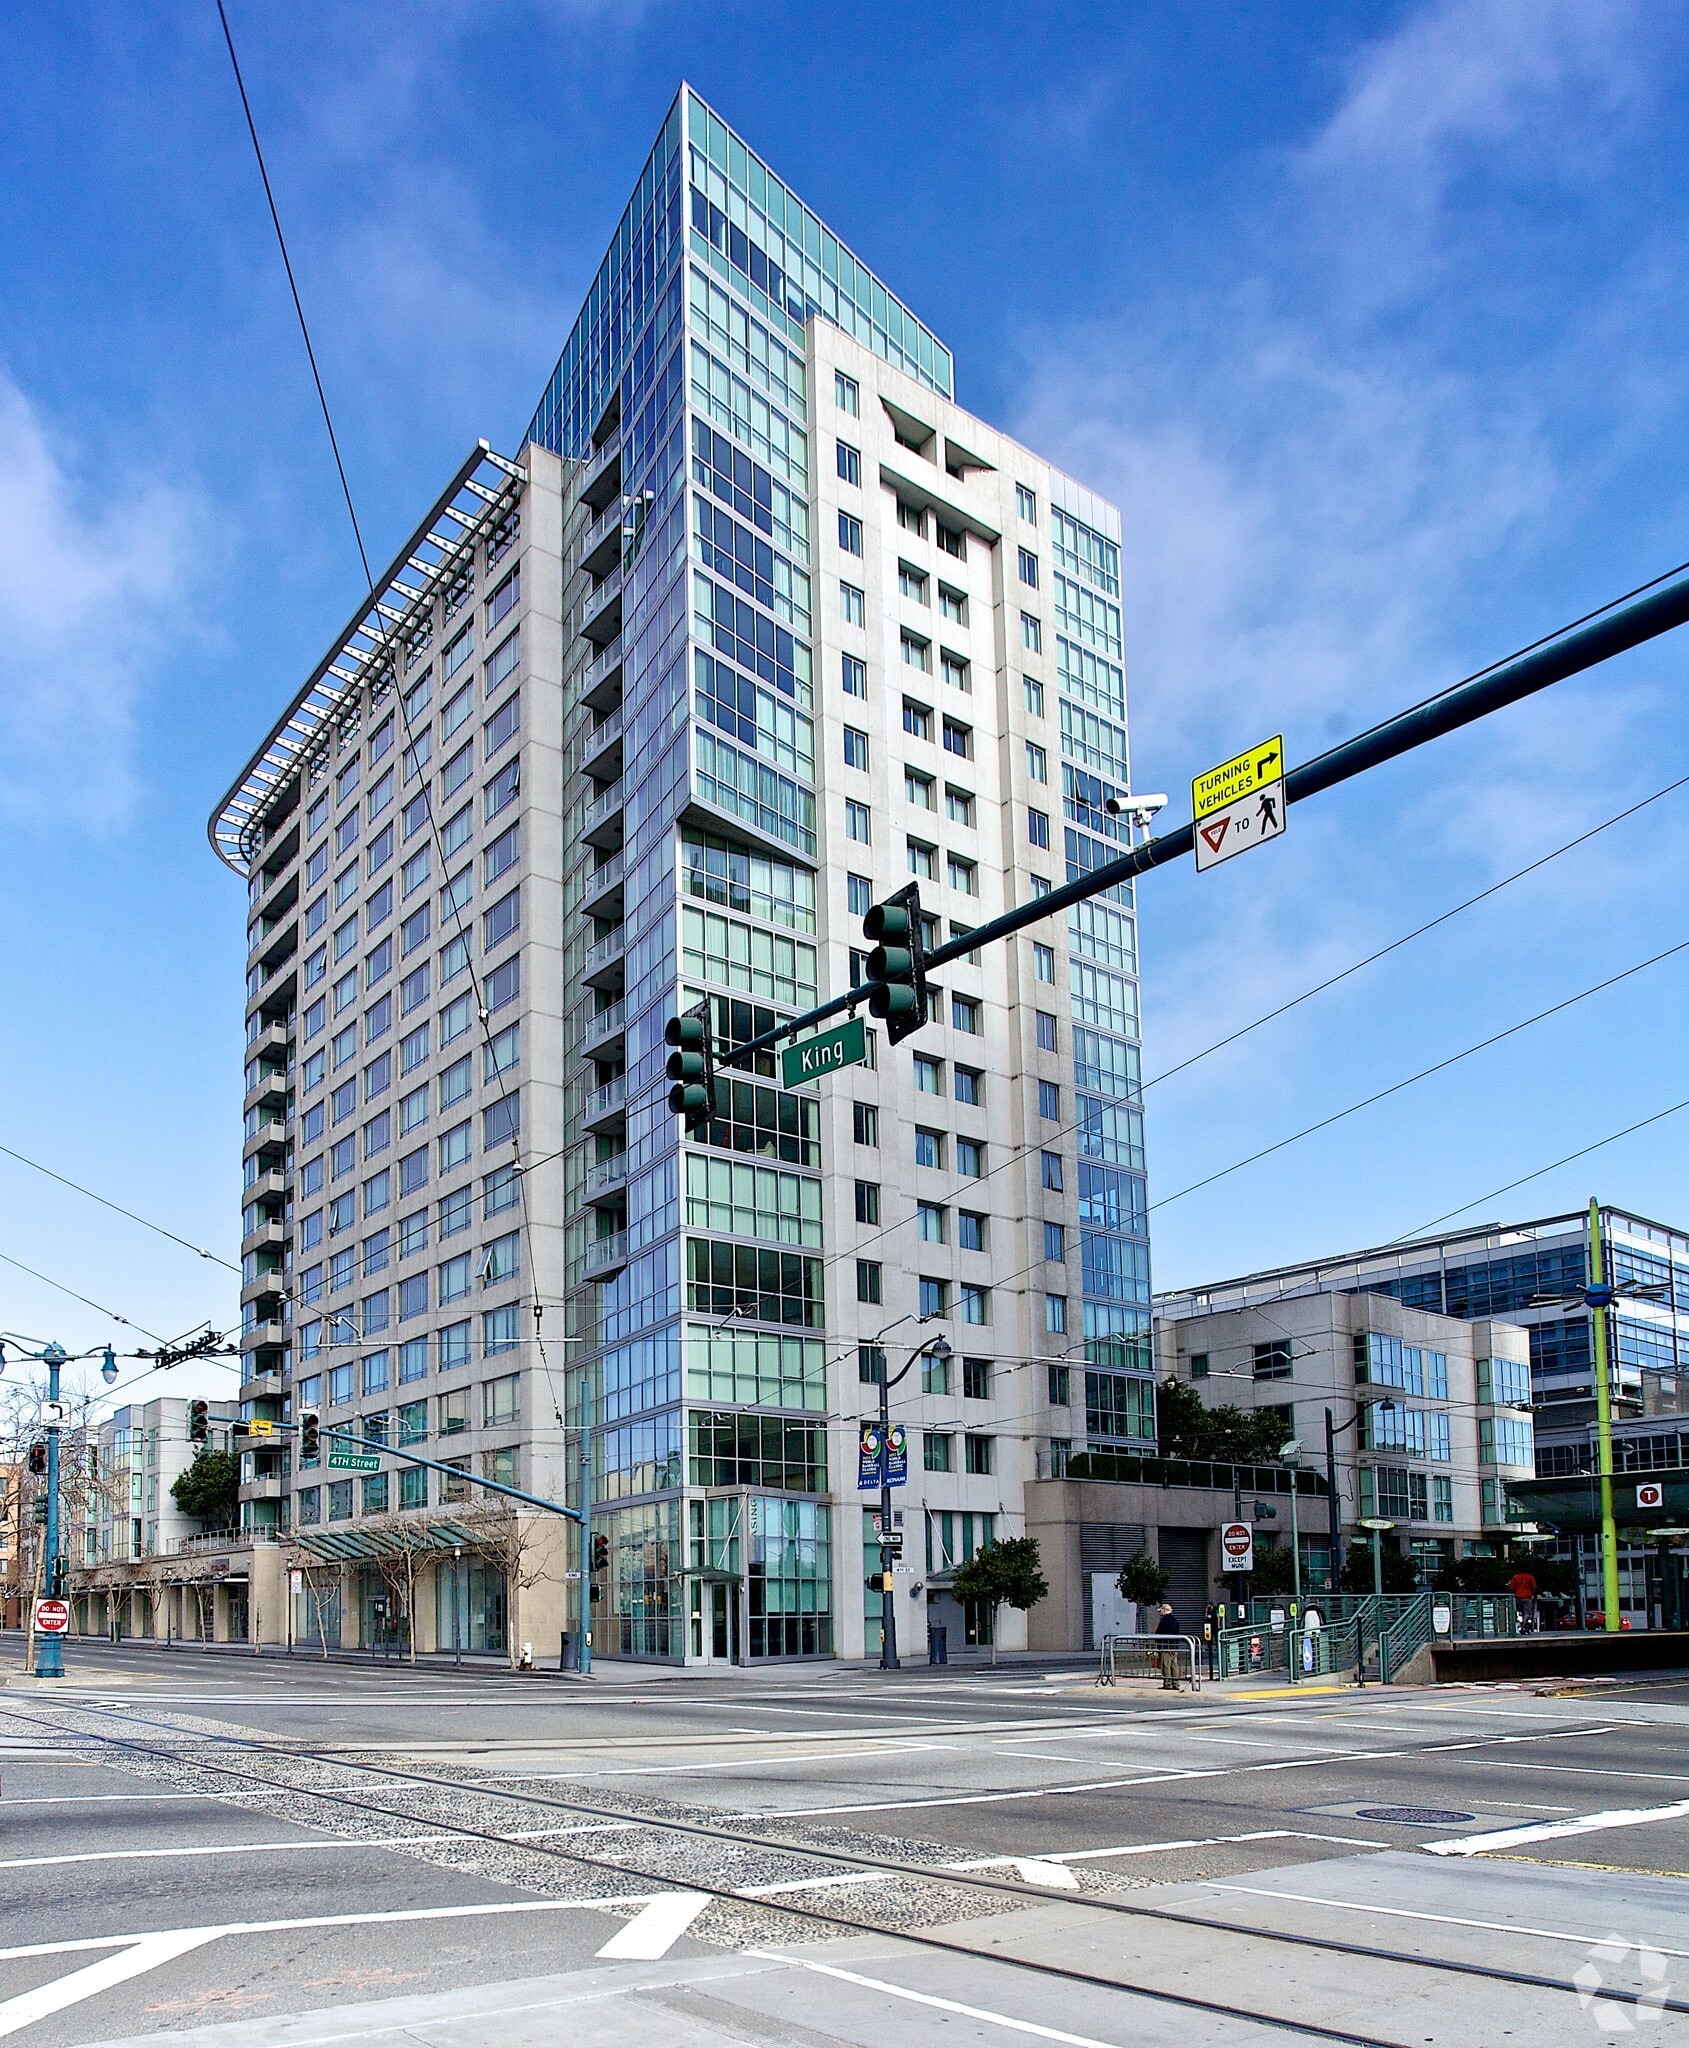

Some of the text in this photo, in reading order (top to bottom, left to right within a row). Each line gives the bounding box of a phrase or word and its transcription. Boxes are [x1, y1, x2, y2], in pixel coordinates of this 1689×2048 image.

[1199, 759, 1250, 793] TURNING
[1199, 775, 1253, 810] VEHICLES
[1235, 817, 1250, 833] TO
[802, 1040, 843, 1073] King
[330, 1456, 378, 1468] 4TH Street
[1644, 1490, 1654, 1501] T
[42, 1619, 62, 1627] ENTER
